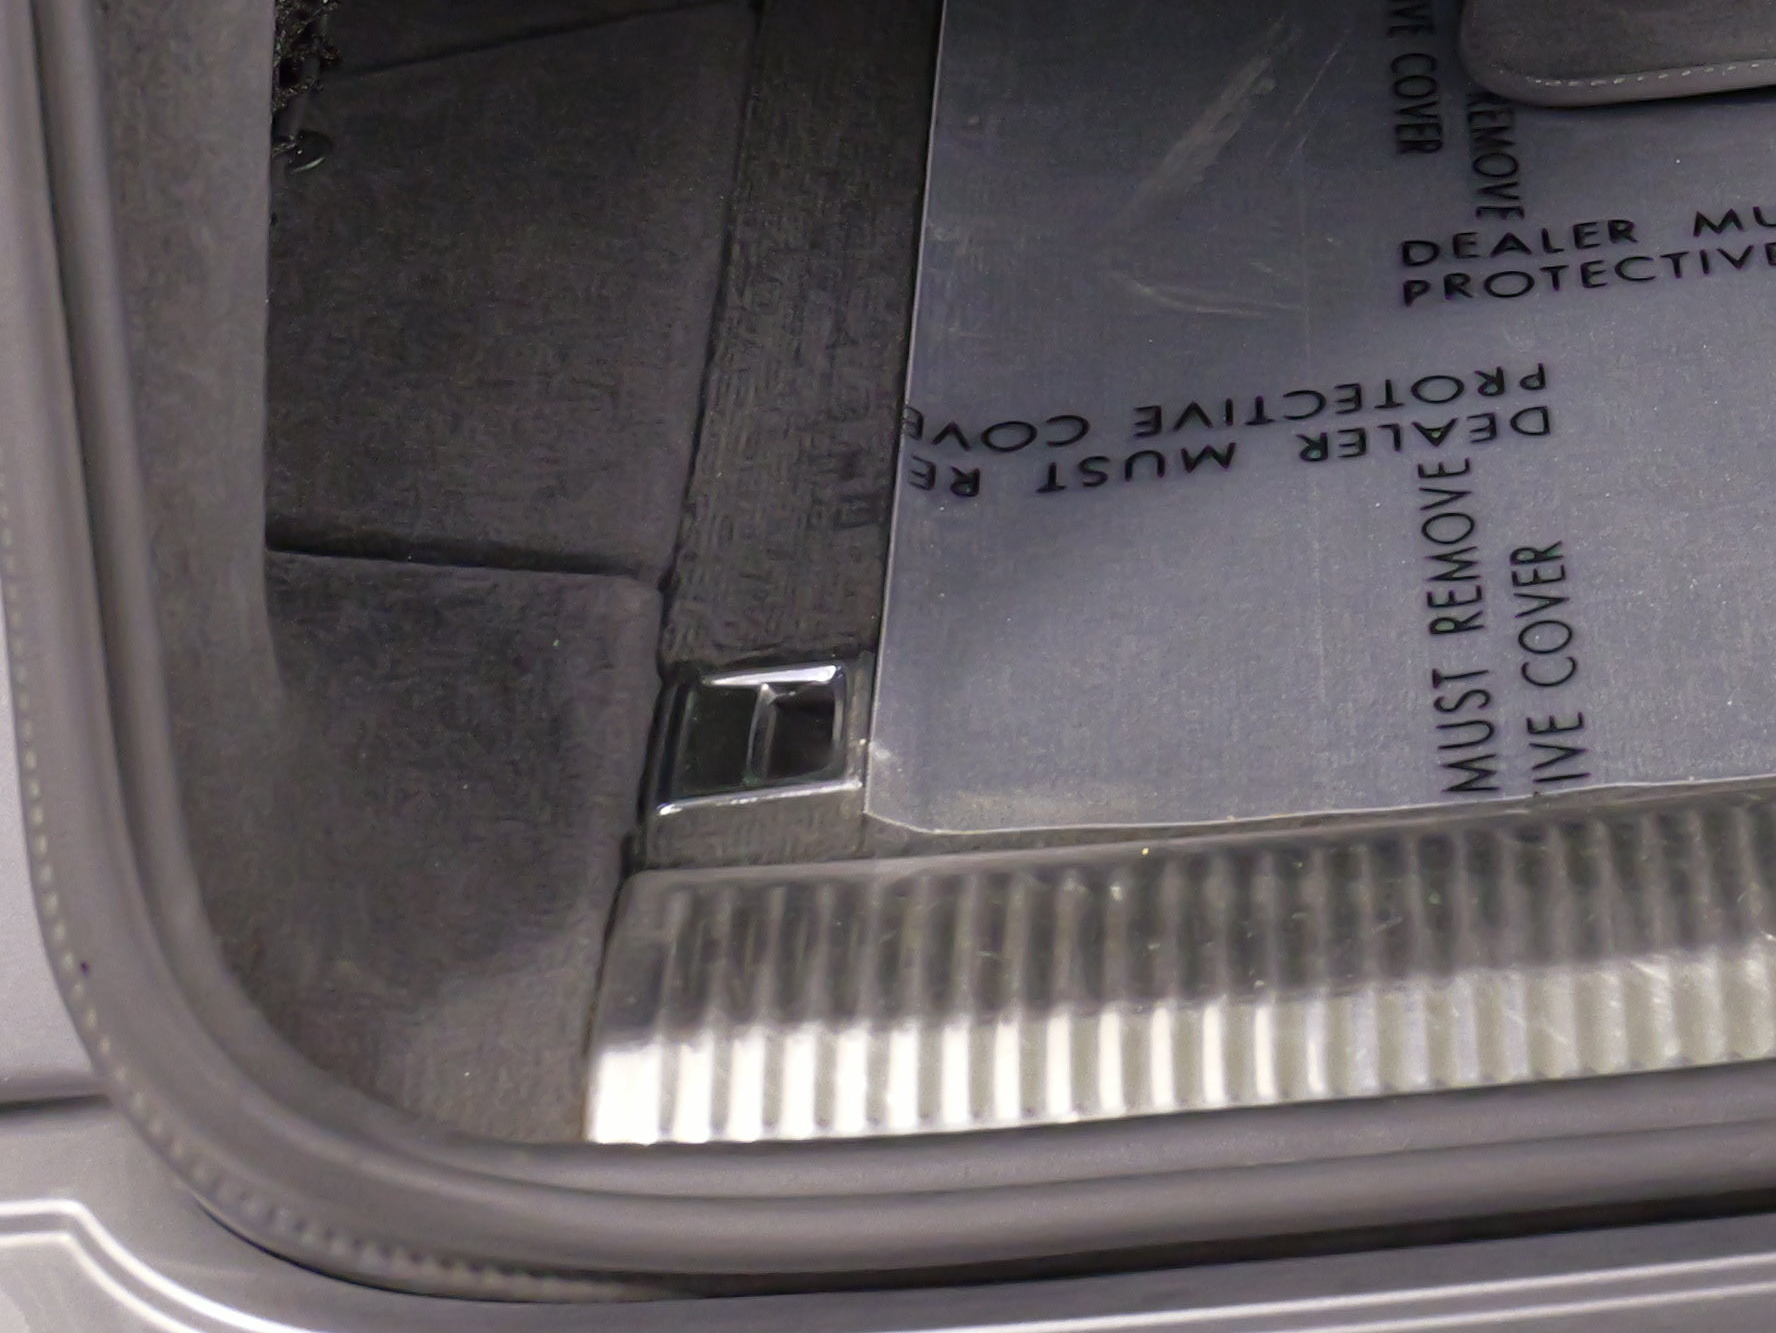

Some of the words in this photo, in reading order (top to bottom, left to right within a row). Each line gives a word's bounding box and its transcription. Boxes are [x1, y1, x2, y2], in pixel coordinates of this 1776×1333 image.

[1391, 53, 1443, 154] COVER
[1401, 218, 1638, 268] DEALER
[1135, 363, 1547, 434] PROTECTIVE
[1298, 406, 1550, 464] DEALER
[1036, 441, 1237, 495] MUST
[1418, 458, 1484, 636] REMOVE
[1511, 539, 1577, 687] COVER
[1434, 669, 1499, 793] MUST
